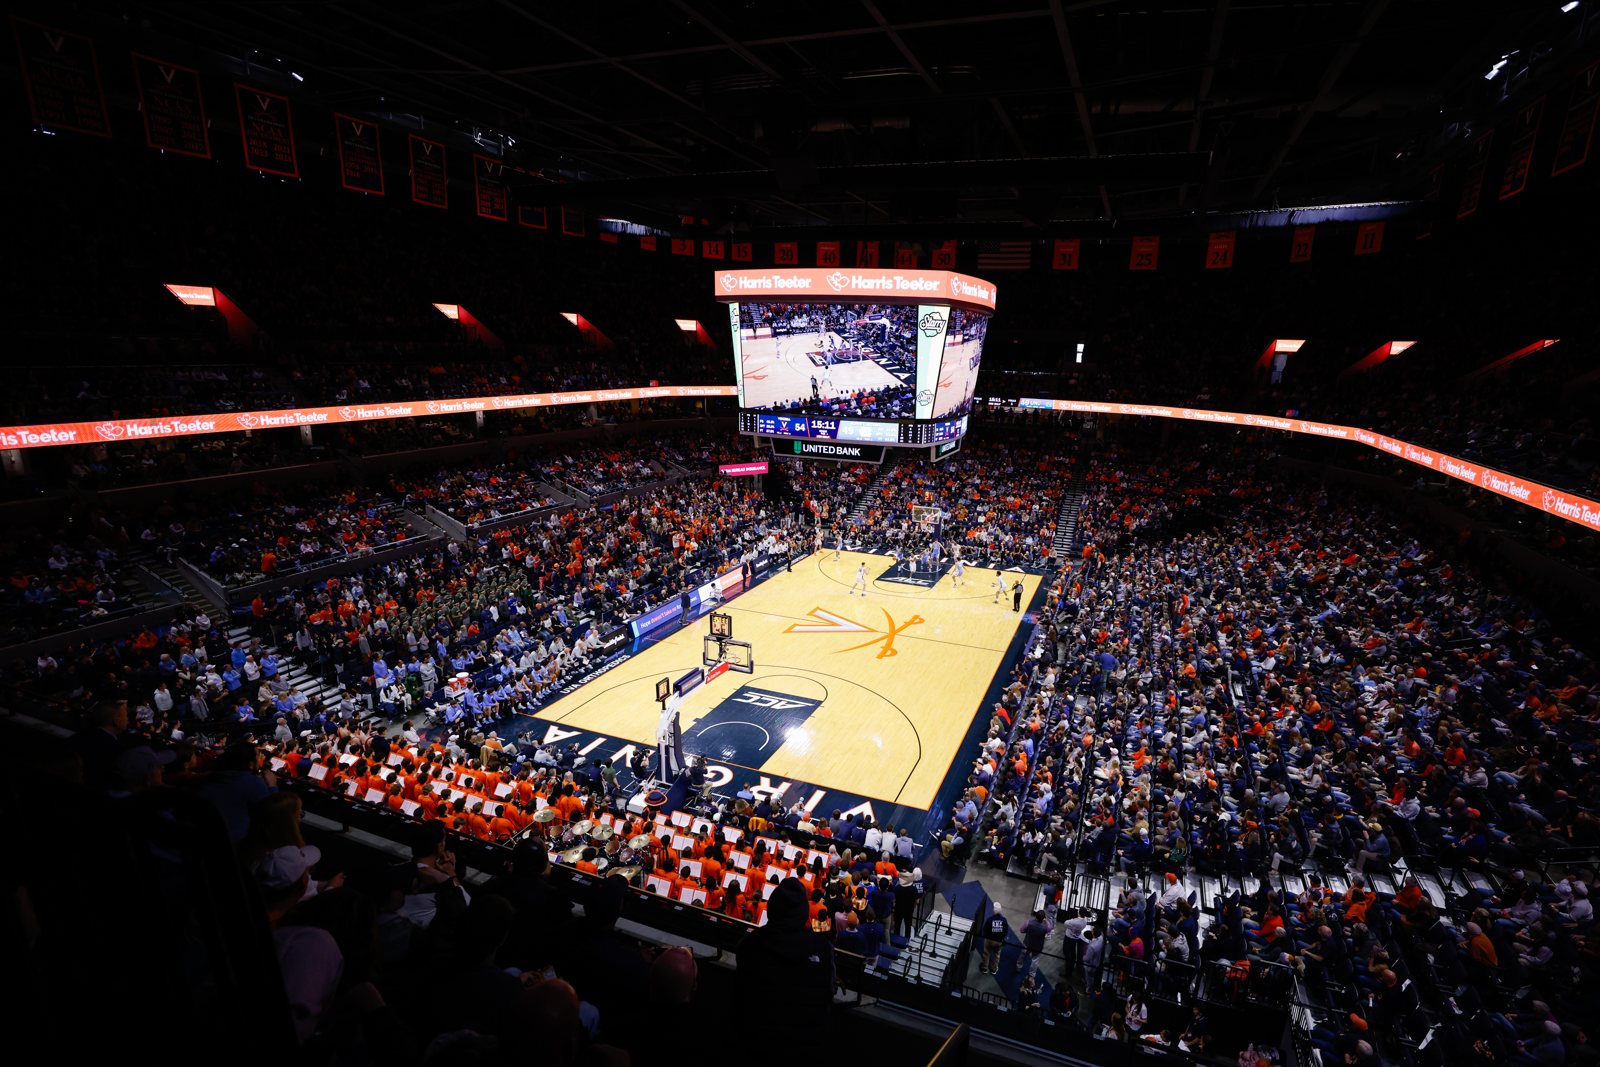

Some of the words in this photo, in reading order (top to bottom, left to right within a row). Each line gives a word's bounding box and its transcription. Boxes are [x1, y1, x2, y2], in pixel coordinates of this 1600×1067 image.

[740, 276, 772, 289] Harris
[772, 275, 811, 289] Teeter
[852, 276, 892, 290] Harris
[893, 276, 940, 290] Teeter
[357, 408, 386, 418] Harris
[386, 406, 412, 416] Teeter
[440, 402, 462, 412] Harris
[462, 401, 485, 410] Teeter
[260, 414, 294, 425] Harris
[294, 412, 328, 422] Teeter
[811, 420, 836, 429] 15:11
[126, 424, 170, 436] Harris
[171, 420, 215, 434] Teeter
[795, 423, 805, 432] 54
[1310, 424, 1328, 433] Harris
[1328, 426, 1347, 437] Teeter
[16, 430, 76, 444] Teeter
[802, 443, 839, 454] UNITED
[841, 447, 860, 456] BANK
[1446, 461, 1460, 476] Harris
[1460, 464, 1476, 481] Teeter
[1490, 474, 1509, 492] Harris
[1509, 480, 1530, 500] Teeter
[1555, 497, 1581, 518] Harris
[1581, 504, 1600, 526] Teet
[560, 683, 581, 694] UVA
[578, 655, 631, 684] ORTHOPEDICS
[731, 690, 815, 709] ACC
